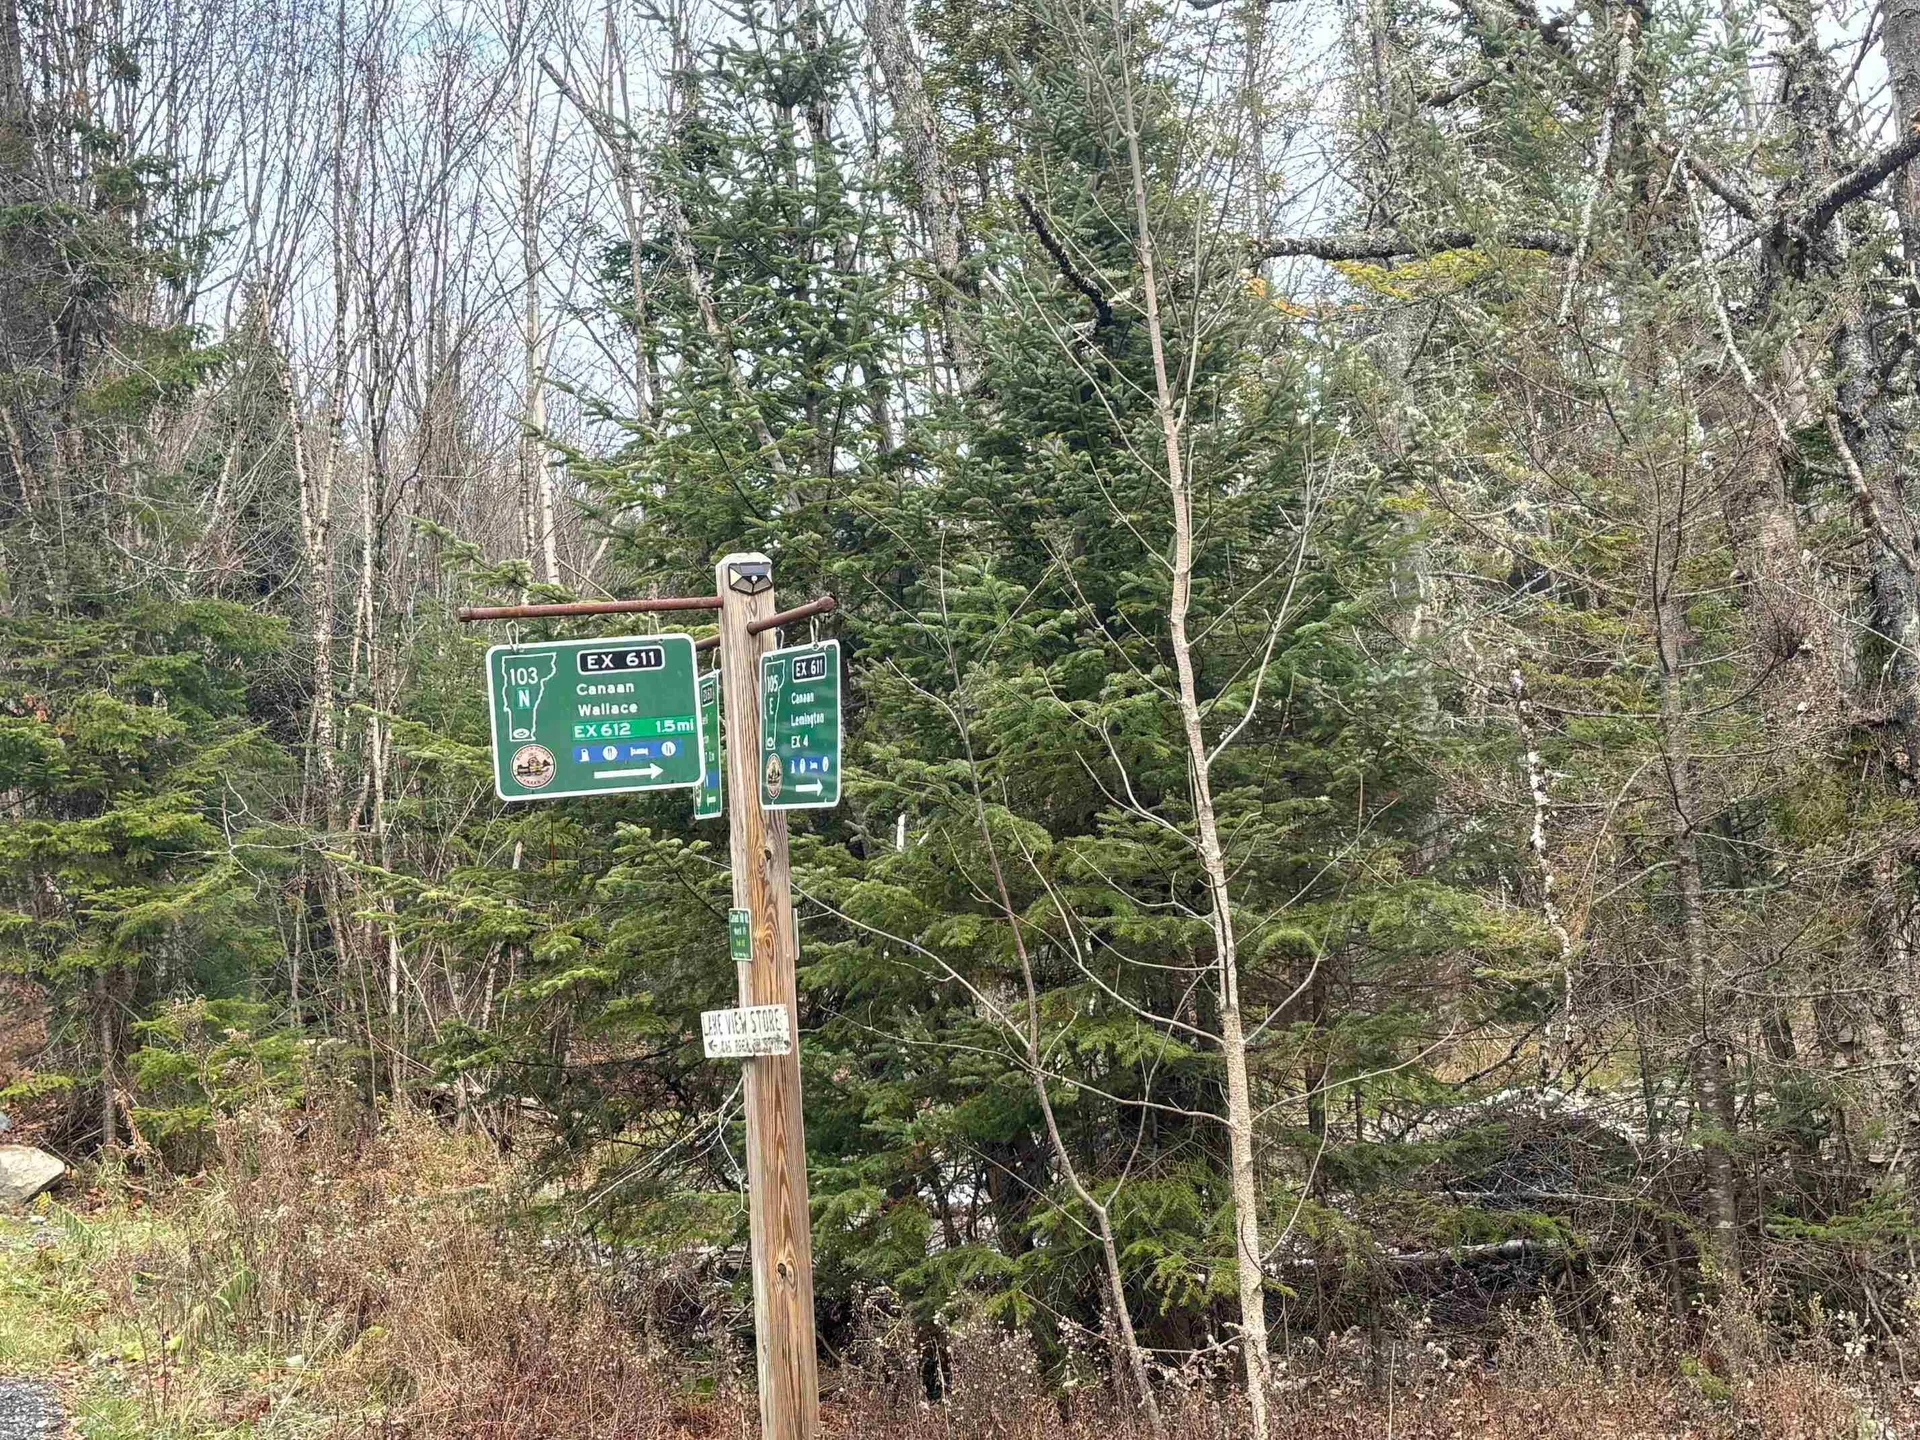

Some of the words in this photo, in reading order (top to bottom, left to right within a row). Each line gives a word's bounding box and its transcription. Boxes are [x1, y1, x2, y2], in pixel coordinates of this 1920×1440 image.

[587, 653, 614, 669] EX
[626, 651, 655, 666] 611
[795, 662, 806, 677] EX
[811, 659, 823, 675] 611
[510, 667, 538, 685] 103
[767, 674, 779, 693] 105
[576, 683, 635, 695] Canaan
[791, 691, 814, 705] Canaan
[518, 690, 530, 708] N
[578, 703, 638, 717] Wallace
[791, 711, 825, 729] Lemington
[574, 724, 598, 738] EX
[600, 722, 631, 736] 612
[791, 735, 801, 749] EX
[803, 734, 809, 747] 4
[725, 1010, 748, 1035] VIEW
[750, 1007, 782, 1036] STORE
